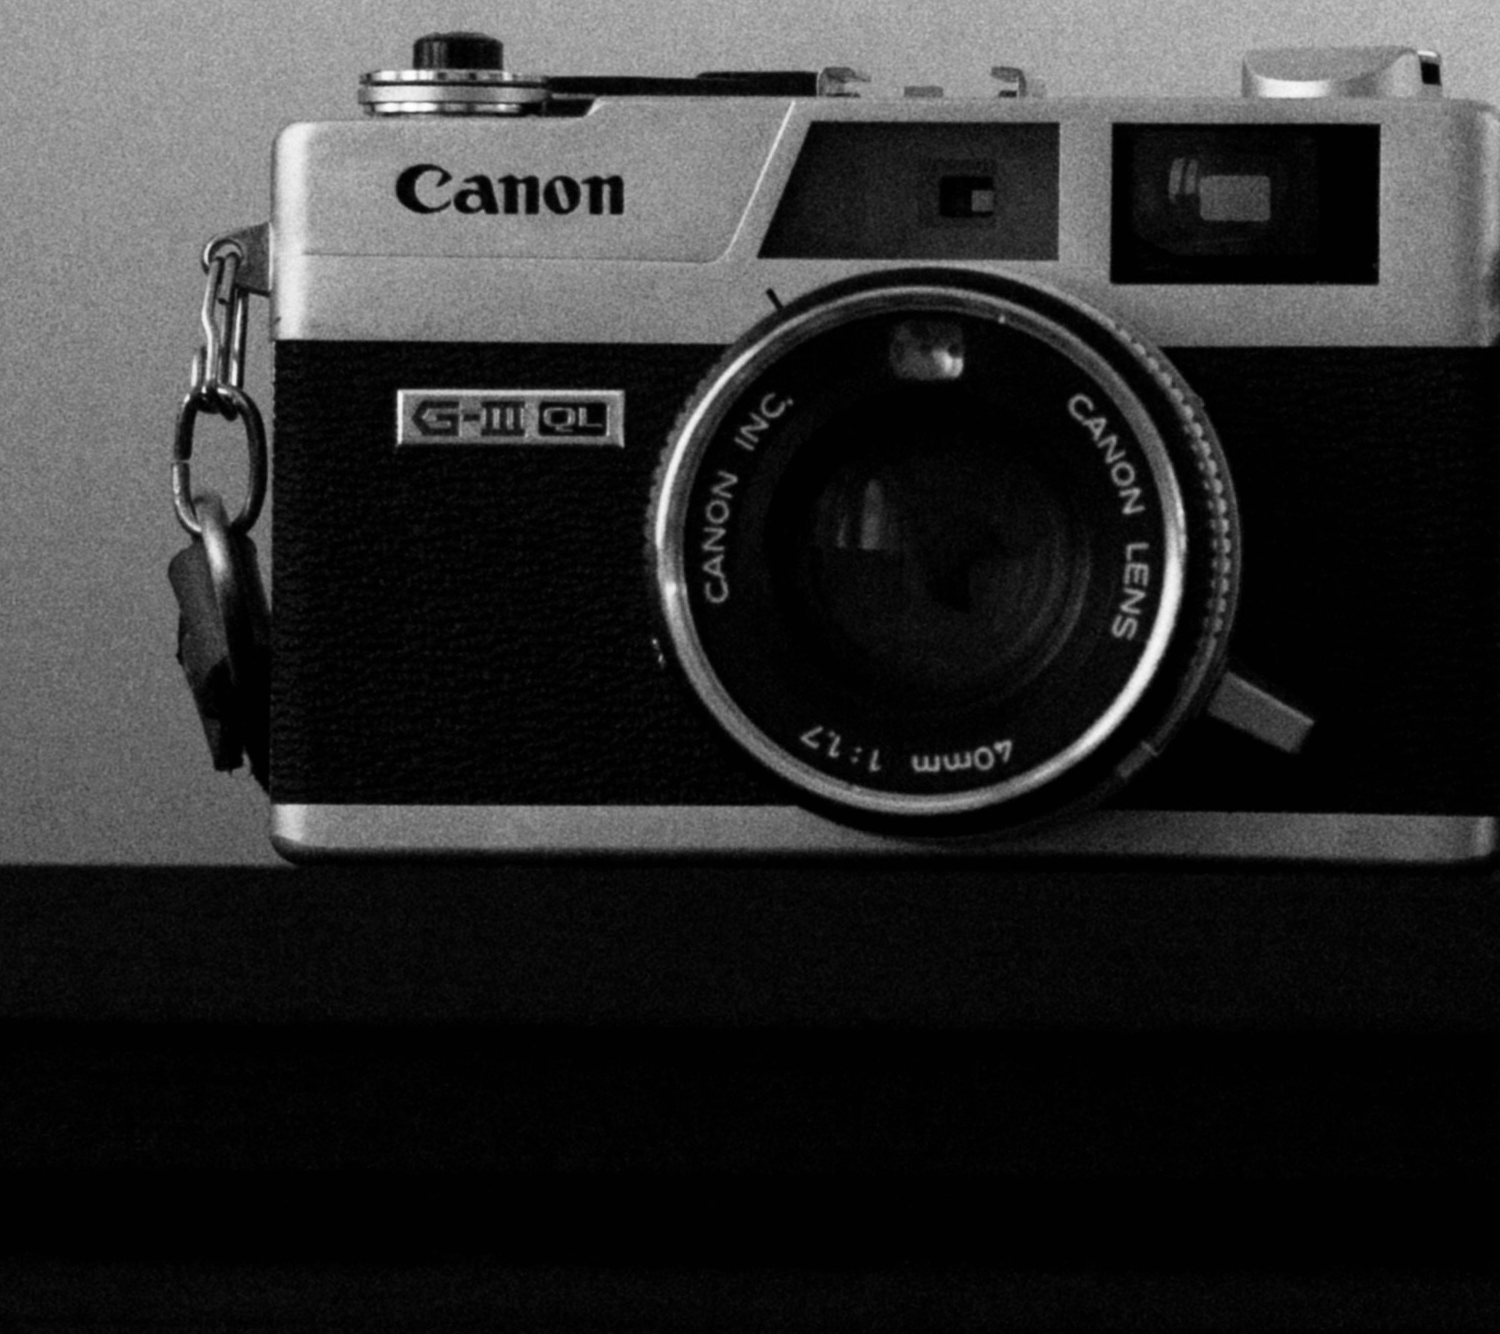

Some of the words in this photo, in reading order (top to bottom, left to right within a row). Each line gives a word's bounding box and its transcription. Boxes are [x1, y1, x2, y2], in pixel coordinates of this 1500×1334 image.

[395, 164, 625, 216] Canon
[702, 470, 739, 604] CANON
[734, 392, 794, 451] INC.
[1068, 393, 1146, 515] CANON
[1111, 542, 1150, 641] LENS
[911, 739, 1013, 773] 40mm
